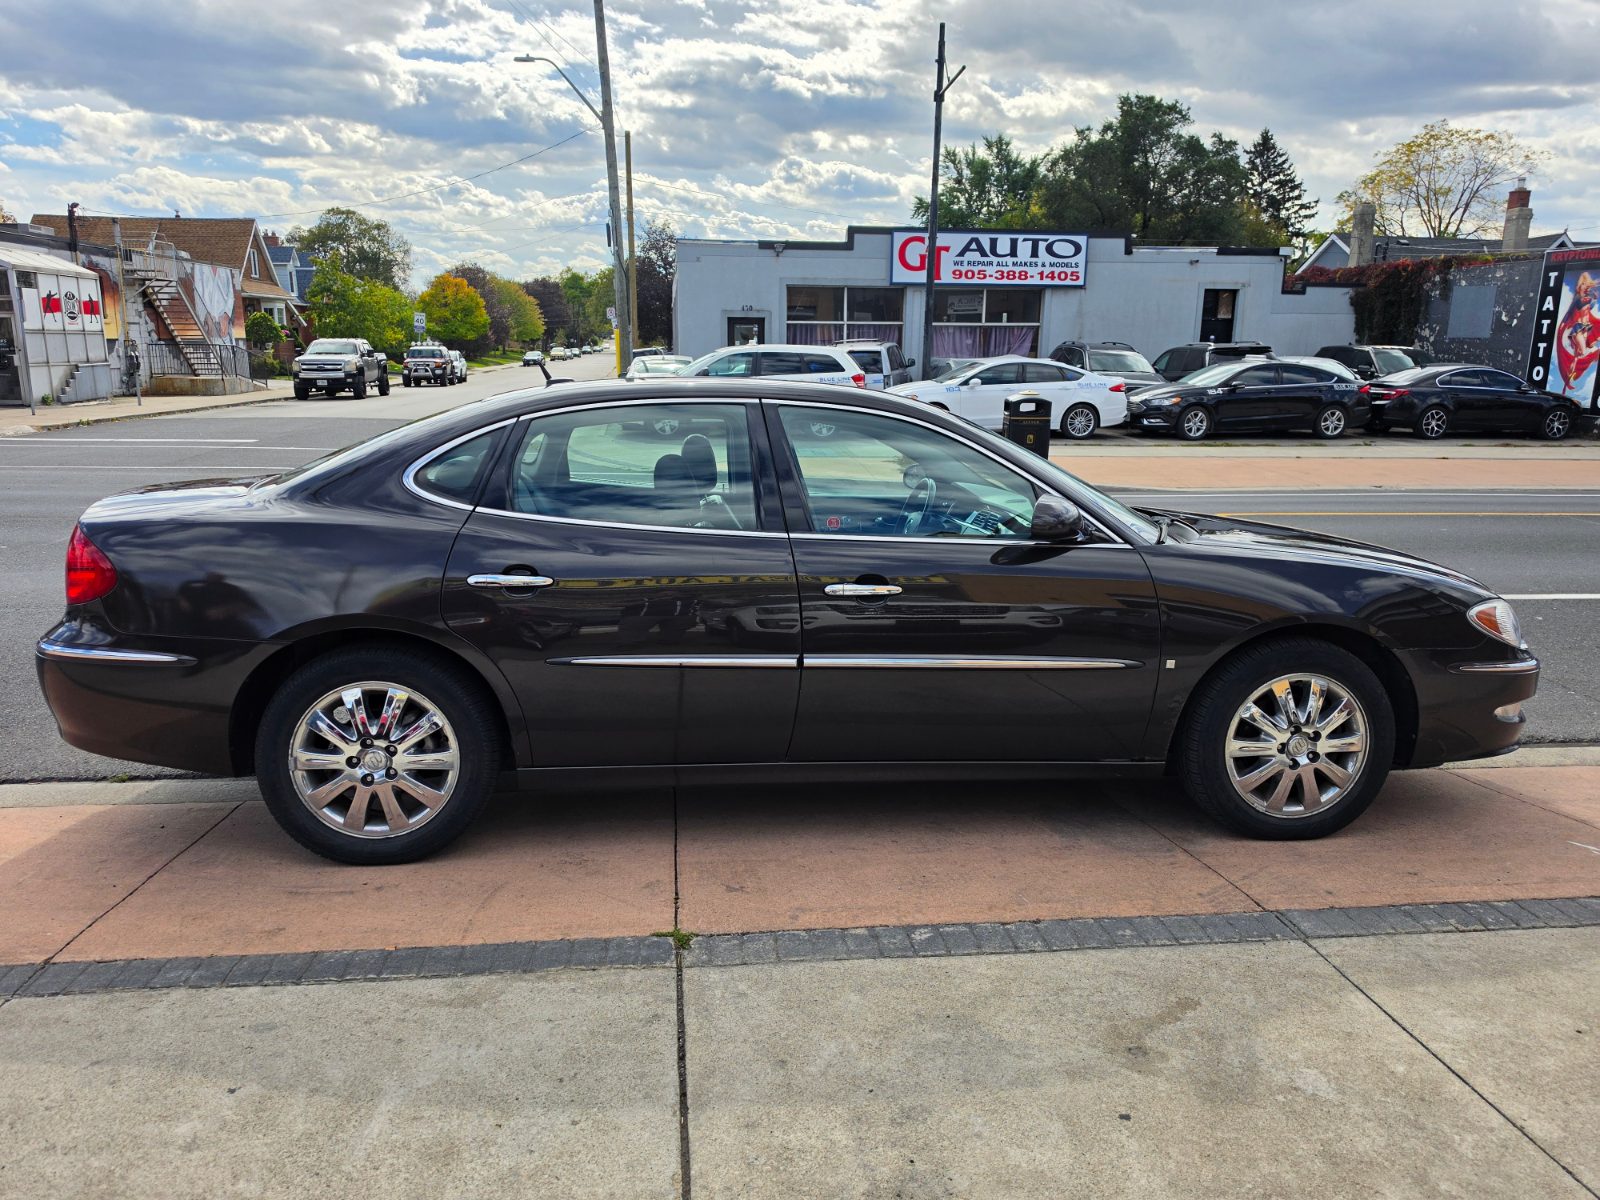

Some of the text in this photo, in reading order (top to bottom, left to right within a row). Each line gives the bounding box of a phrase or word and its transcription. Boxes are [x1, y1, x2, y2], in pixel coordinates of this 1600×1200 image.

[898, 235, 1083, 281] GT AUTO
[952, 269, 1080, 282] 905-388-1405
